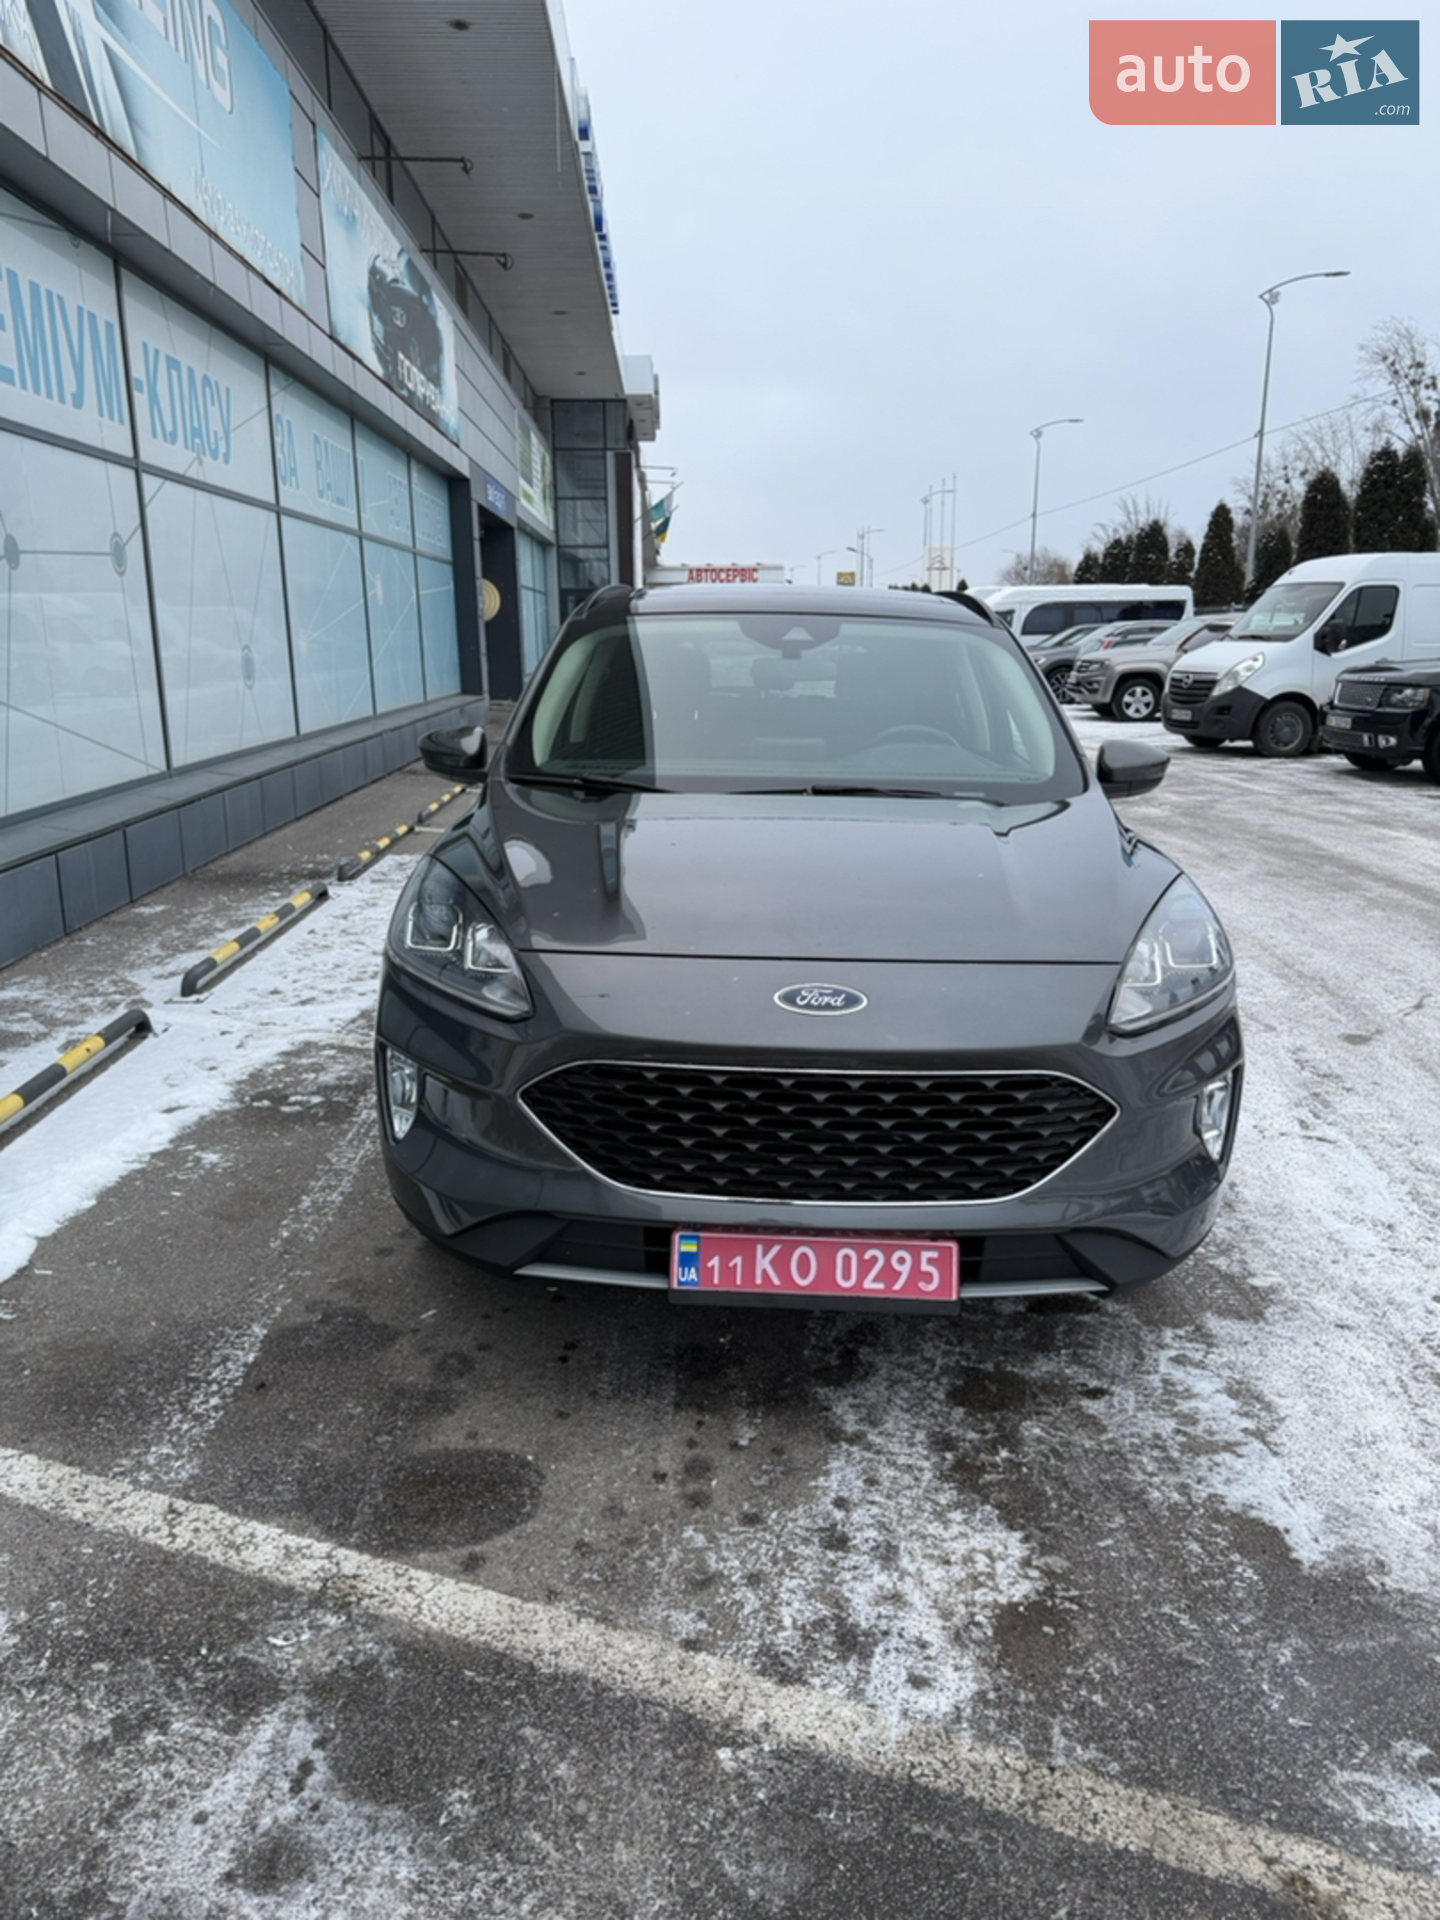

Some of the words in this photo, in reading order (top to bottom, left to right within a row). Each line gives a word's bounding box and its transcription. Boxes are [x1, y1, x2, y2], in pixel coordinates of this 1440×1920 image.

[131, 0, 234, 114] ING
[275, 412, 300, 490] ЗА
[687, 568, 759, 583] АВТОСЕРВІС
[796, 987, 846, 1007] Ford
[679, 1267, 698, 1282] UA
[835, 1247, 940, 1292] 0295
